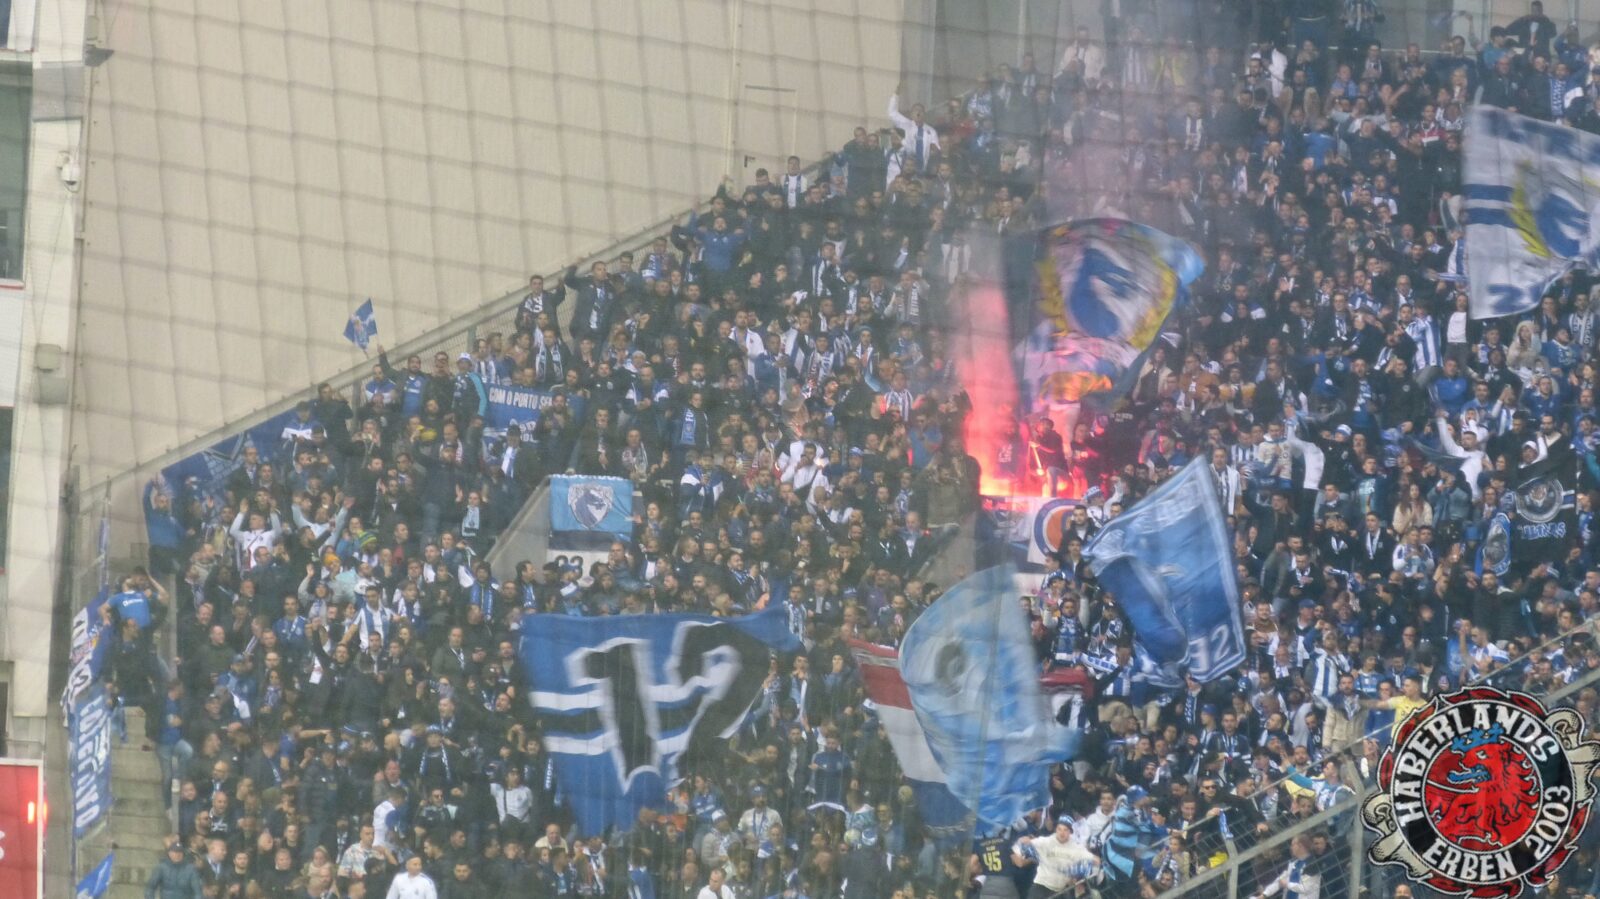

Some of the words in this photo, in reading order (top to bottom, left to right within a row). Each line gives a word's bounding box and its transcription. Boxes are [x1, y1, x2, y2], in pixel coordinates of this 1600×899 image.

[489, 386, 506, 404] COM
[506, 390, 513, 406] O
[513, 391, 538, 410] PORTO
[982, 850, 1002, 872] 45
